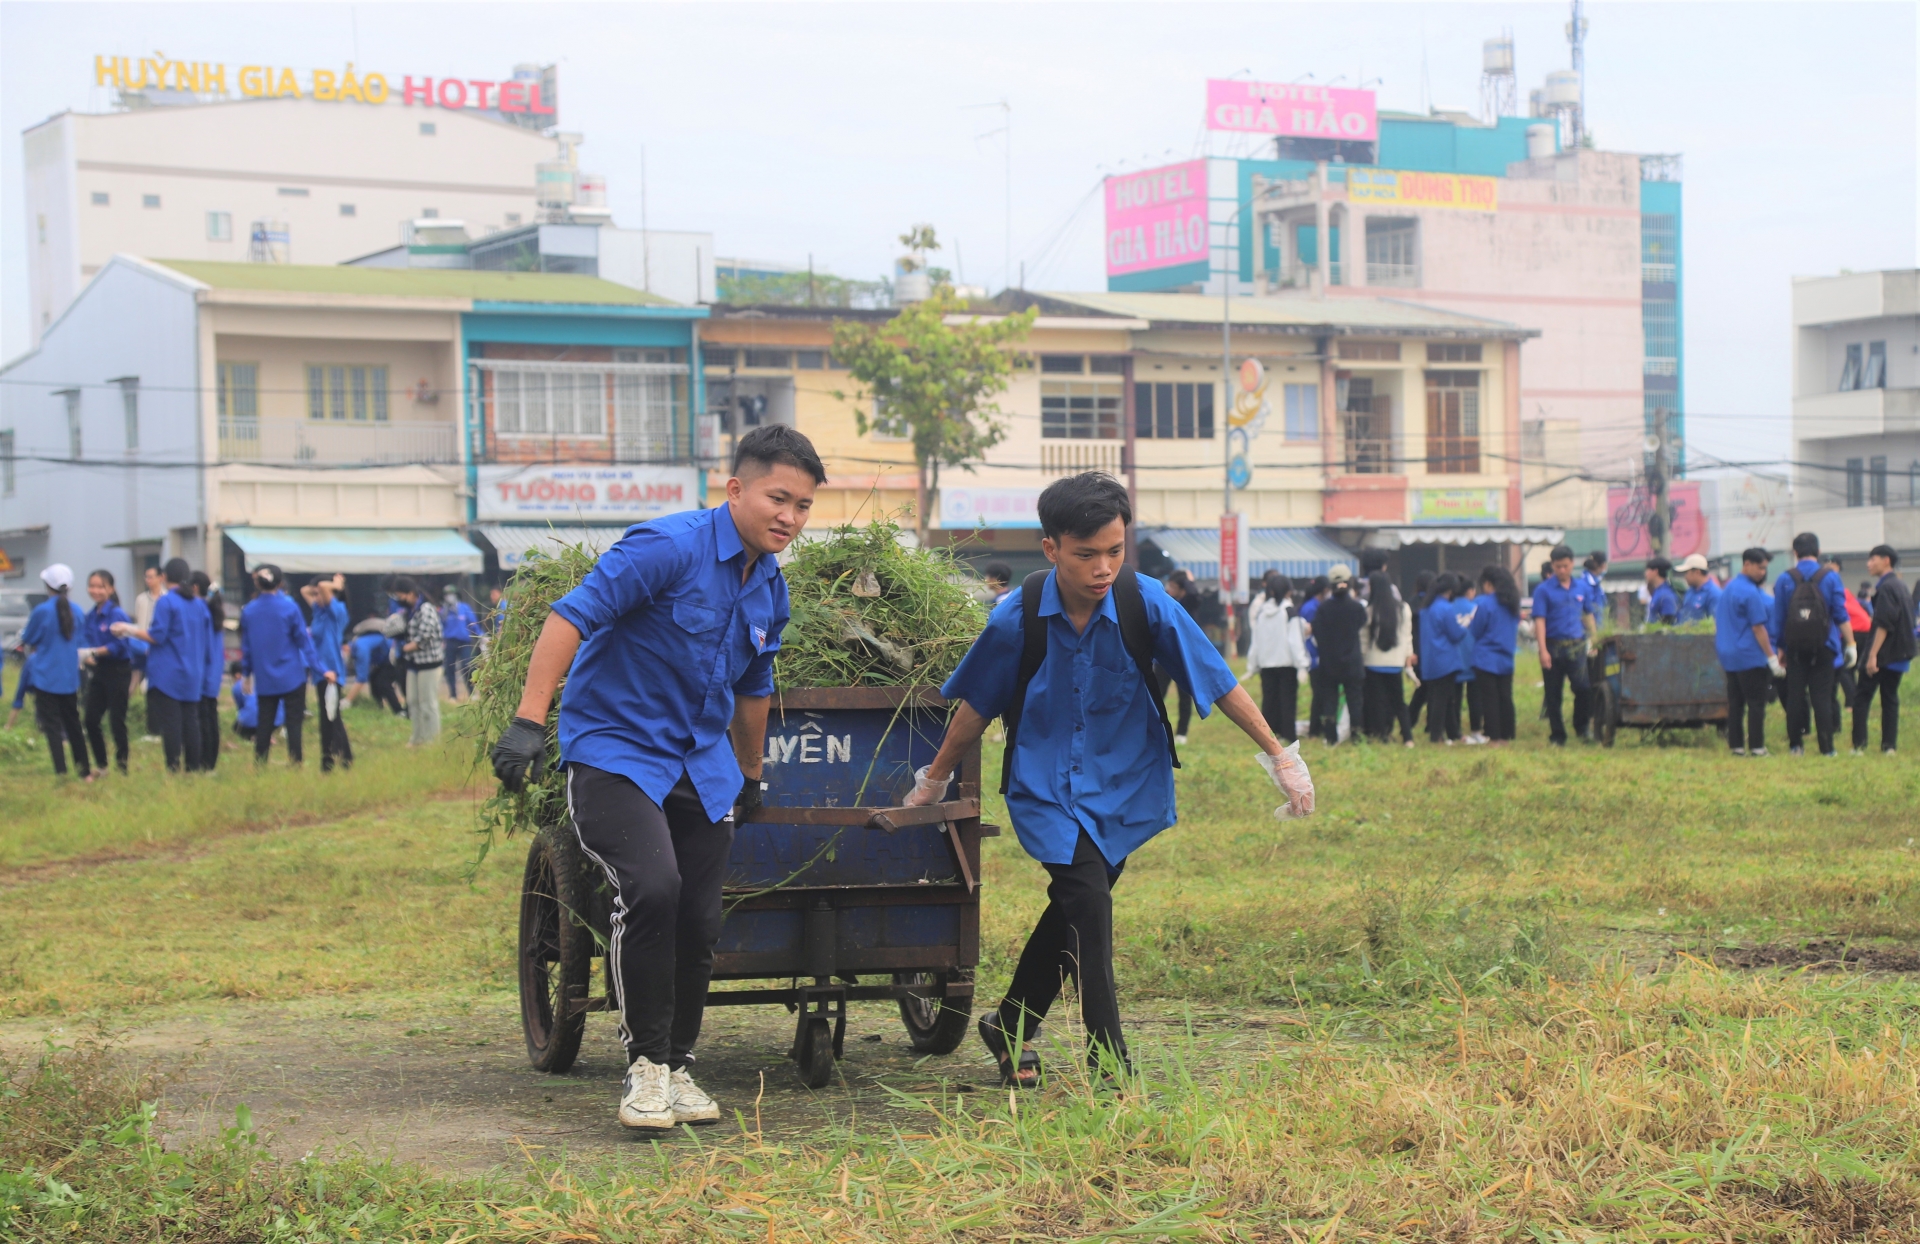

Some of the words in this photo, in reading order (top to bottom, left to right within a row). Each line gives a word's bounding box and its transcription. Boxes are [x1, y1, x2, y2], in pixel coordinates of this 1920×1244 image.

[95, 50, 226, 94] HUỲNH
[238, 65, 303, 99] GIA
[312, 61, 389, 104] BẢO
[402, 75, 555, 114] HOTEL
[1249, 83, 1335, 103] HOTEL
[1215, 104, 1279, 130] GIA
[1291, 104, 1368, 136] HẢO
[1115, 167, 1195, 211] HOTEL
[1109, 224, 1149, 266] GIA
[608, 483, 683, 501] SANH
